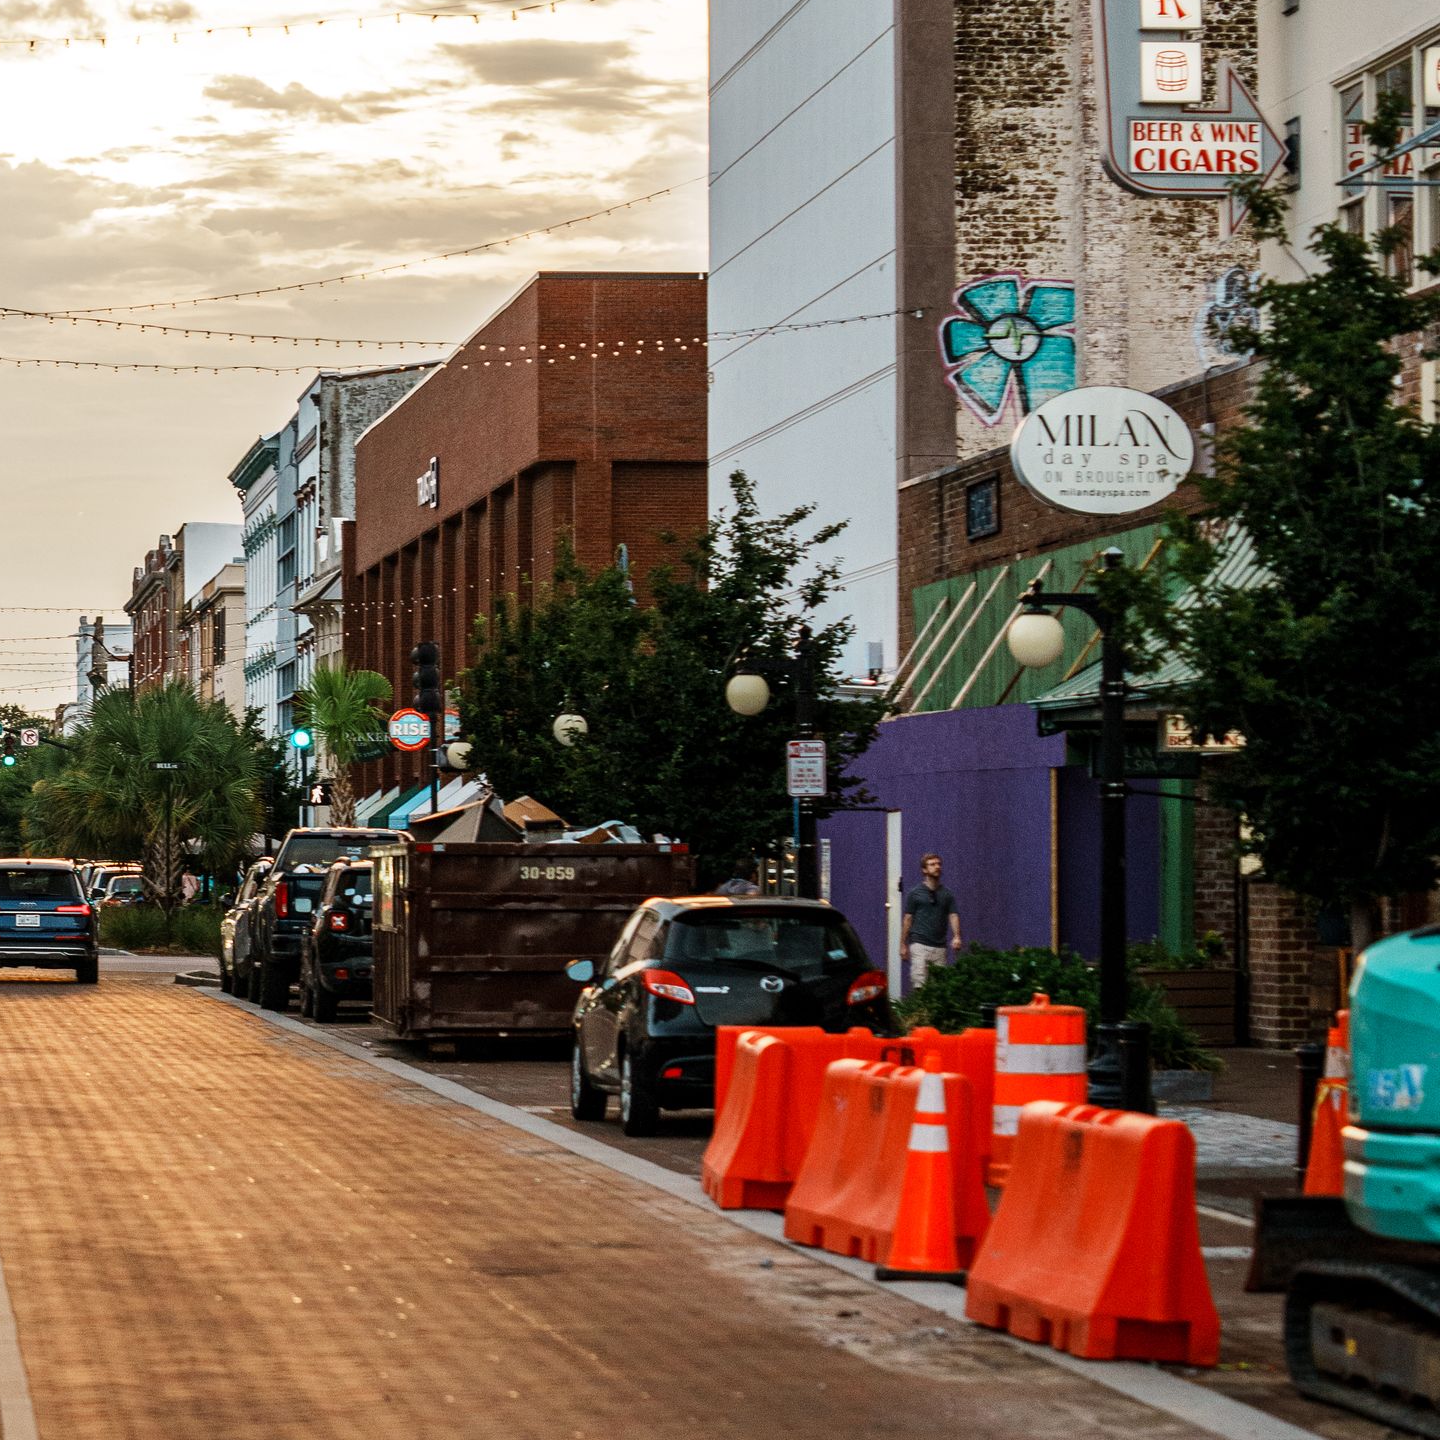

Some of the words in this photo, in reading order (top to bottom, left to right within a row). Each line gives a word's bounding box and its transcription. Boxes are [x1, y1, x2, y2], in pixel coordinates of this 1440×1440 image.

[1133, 121, 1183, 142] BEER
[1190, 122, 1204, 143] &
[1210, 123, 1260, 143] WINE
[1133, 147, 1260, 173] CIGARS
[1036, 410, 1188, 460] MILAN
[1043, 448, 1093, 468] day
[1118, 453, 1169, 469] spa
[1043, 470, 1064, 484] ON
[1059, 488, 1152, 497] milandayspa.com
[392, 723, 430, 736] RISE
[520, 866, 576, 880] 30-859
